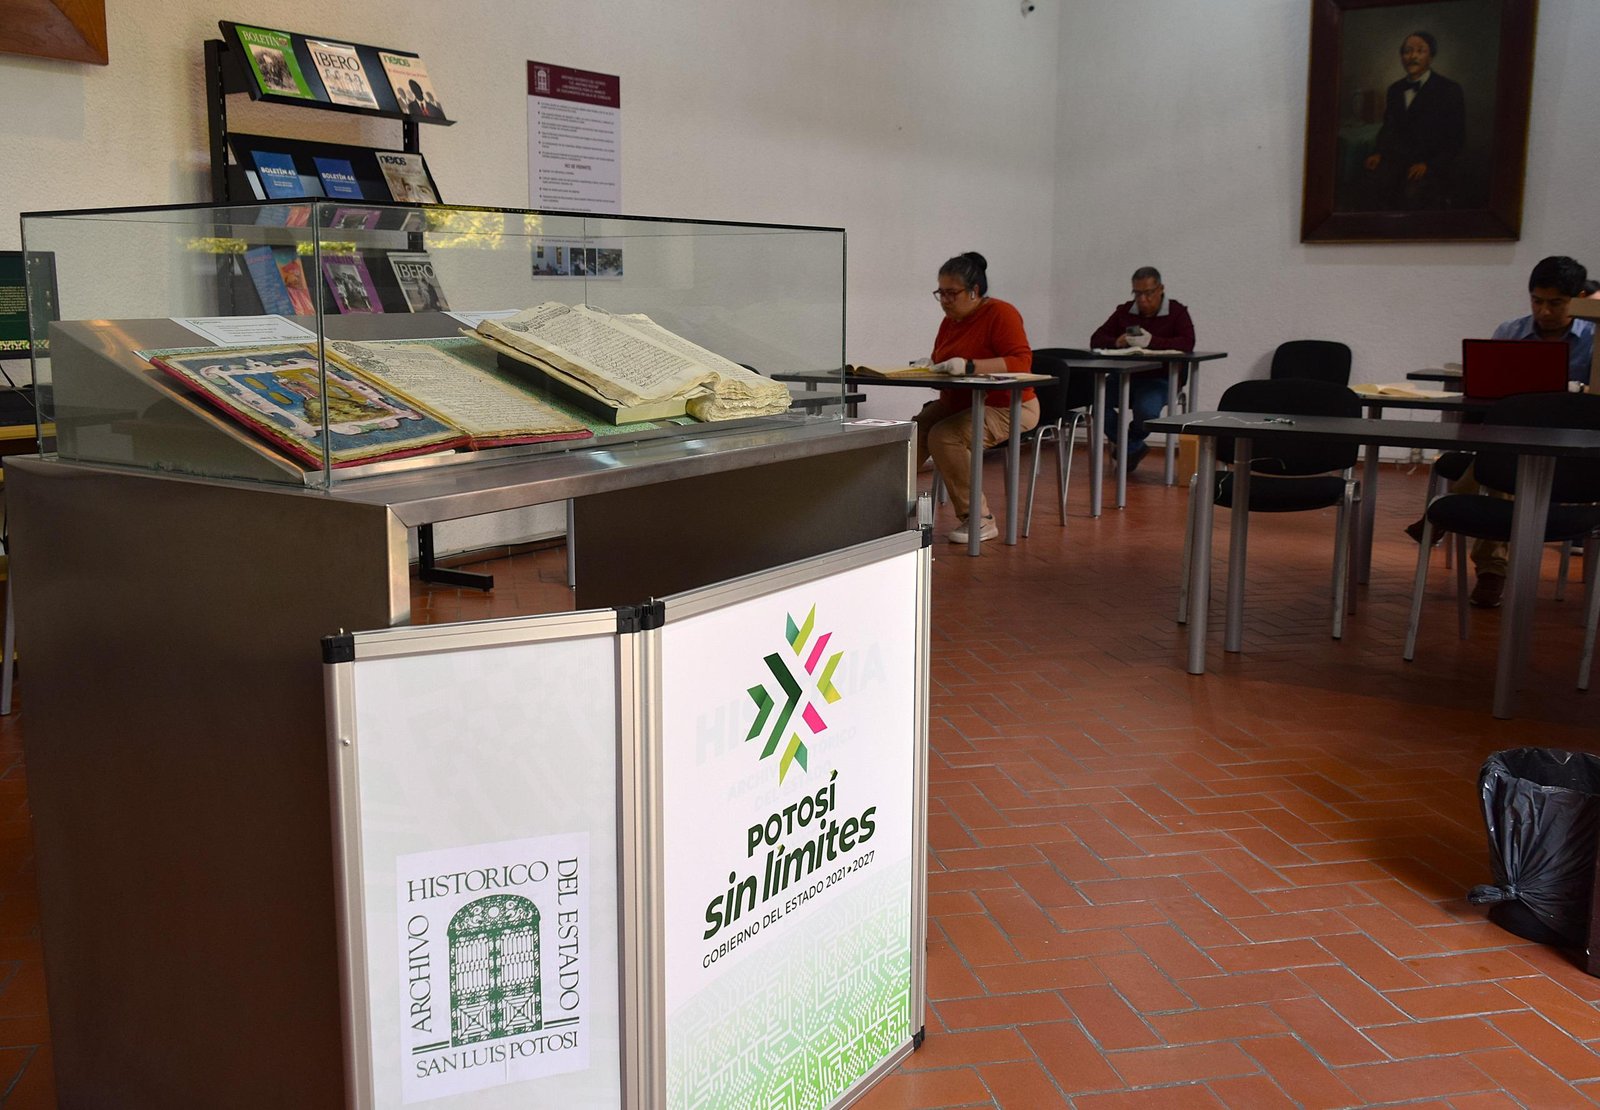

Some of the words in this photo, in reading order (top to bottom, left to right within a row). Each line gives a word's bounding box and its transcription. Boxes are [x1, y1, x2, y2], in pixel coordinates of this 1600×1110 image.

[314, 51, 360, 72] IBERO
[395, 263, 435, 279] IBERO
[747, 769, 838, 858] POTOSÍ
[407, 860, 549, 903] HISTORICO
[557, 856, 579, 906] DEL
[703, 871, 758, 940] sin
[762, 806, 877, 904] límites
[702, 922, 760, 969] GOBIERNO
[763, 907, 783, 928] DEL
[785, 878, 824, 915] ESTADO
[407, 915, 433, 1033] ARCHIVO
[557, 909, 580, 1011] ESTADO
[416, 1053, 457, 1078] SAN
[462, 1042, 506, 1069] LUIS
[510, 1031, 578, 1060] POTOSI
